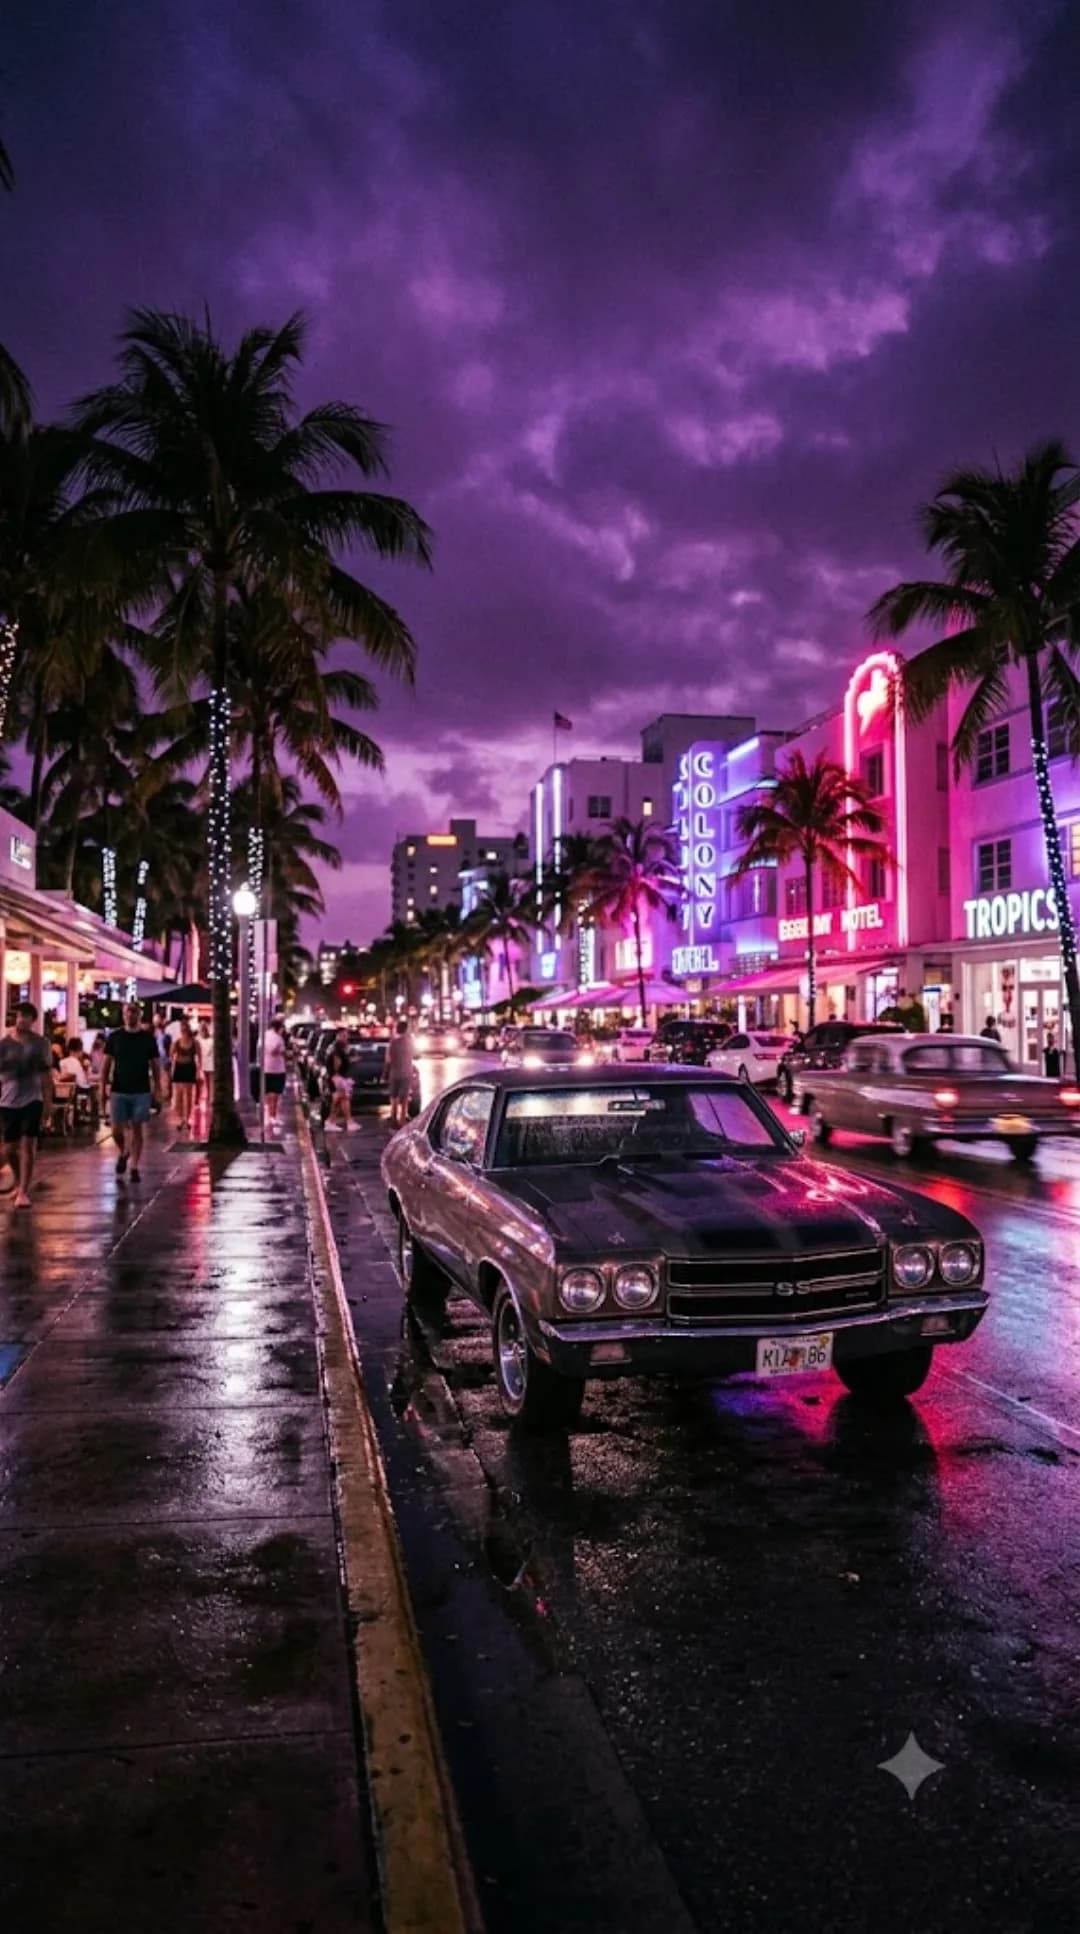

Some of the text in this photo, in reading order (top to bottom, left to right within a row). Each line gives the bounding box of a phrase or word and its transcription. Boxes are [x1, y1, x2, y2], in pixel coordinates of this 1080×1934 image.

[694, 752, 716, 928] COLONY
[963, 888, 1060, 939] TROPICS
[776, 1281, 811, 1297] SS
